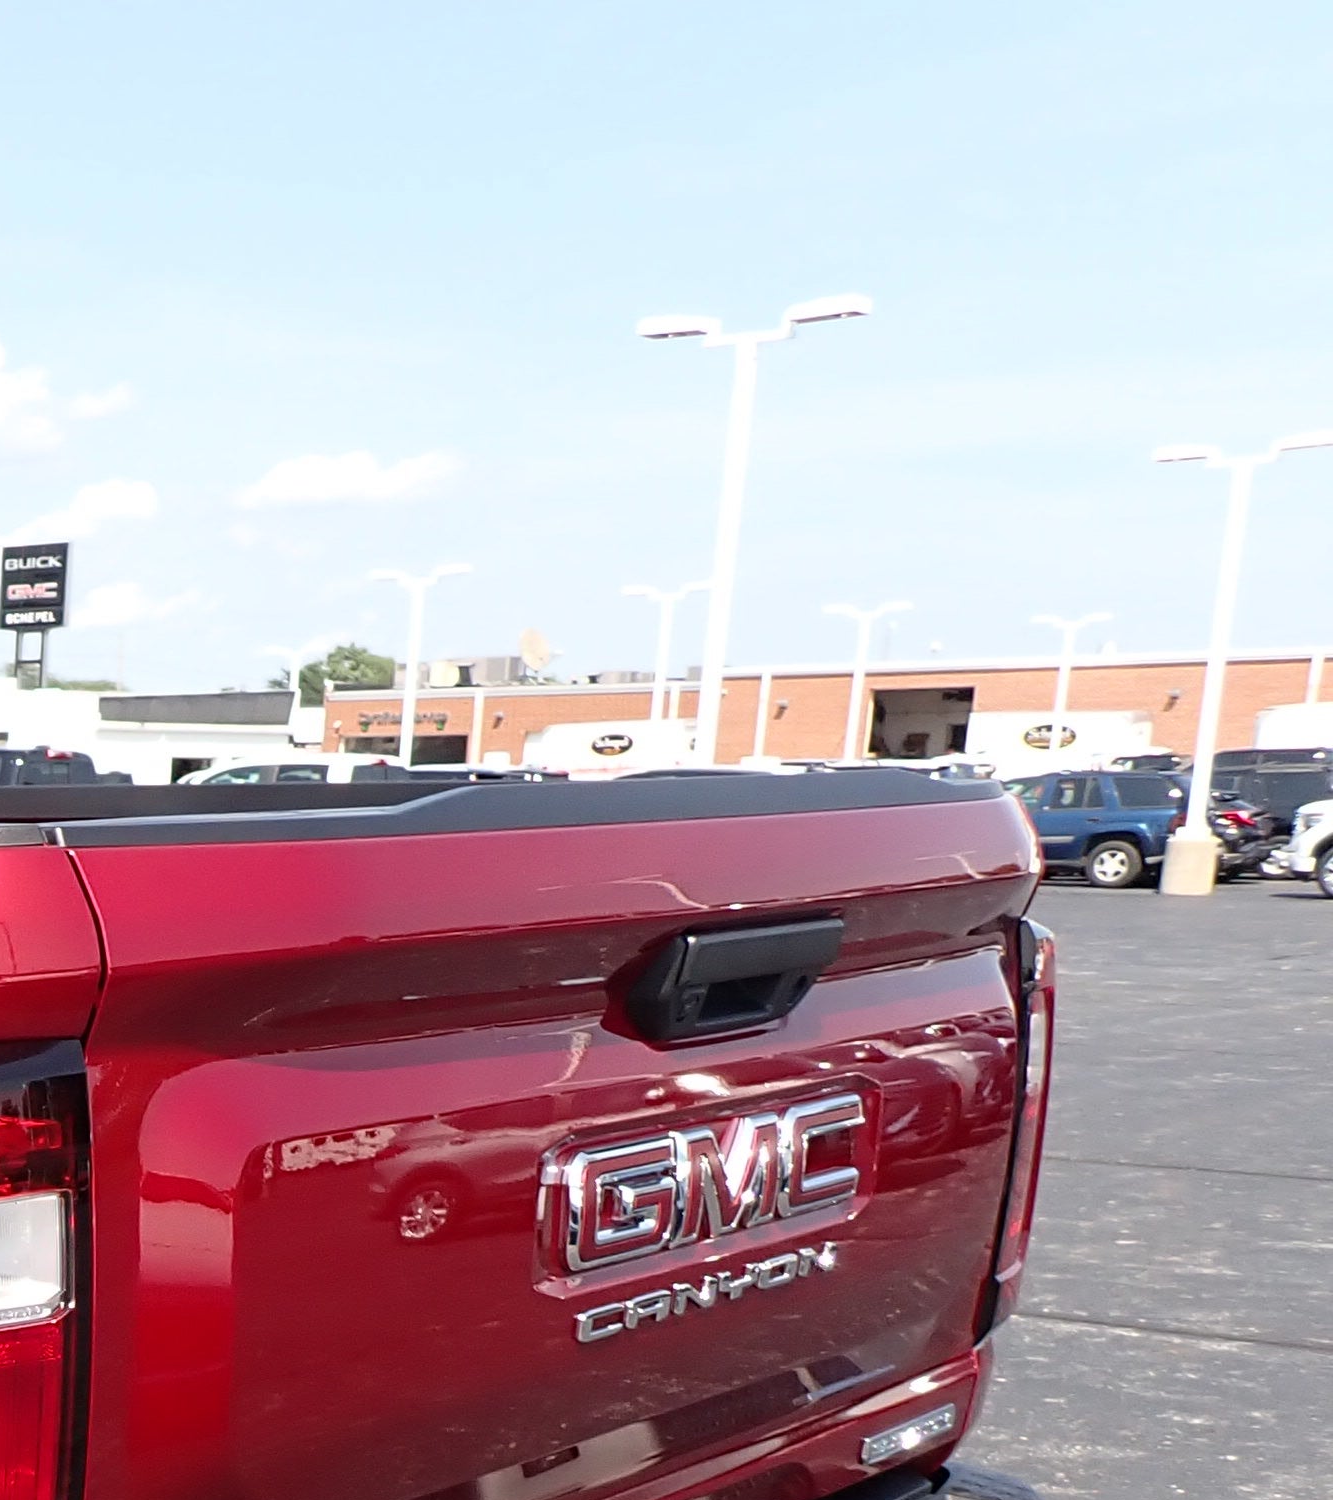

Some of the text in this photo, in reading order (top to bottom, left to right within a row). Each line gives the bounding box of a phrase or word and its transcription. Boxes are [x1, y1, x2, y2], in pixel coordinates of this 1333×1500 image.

[4, 556, 63, 571] BUICK
[7, 582, 58, 600] GMC
[566, 1093, 866, 1271] GMC
[575, 1241, 838, 1343] CANYON
